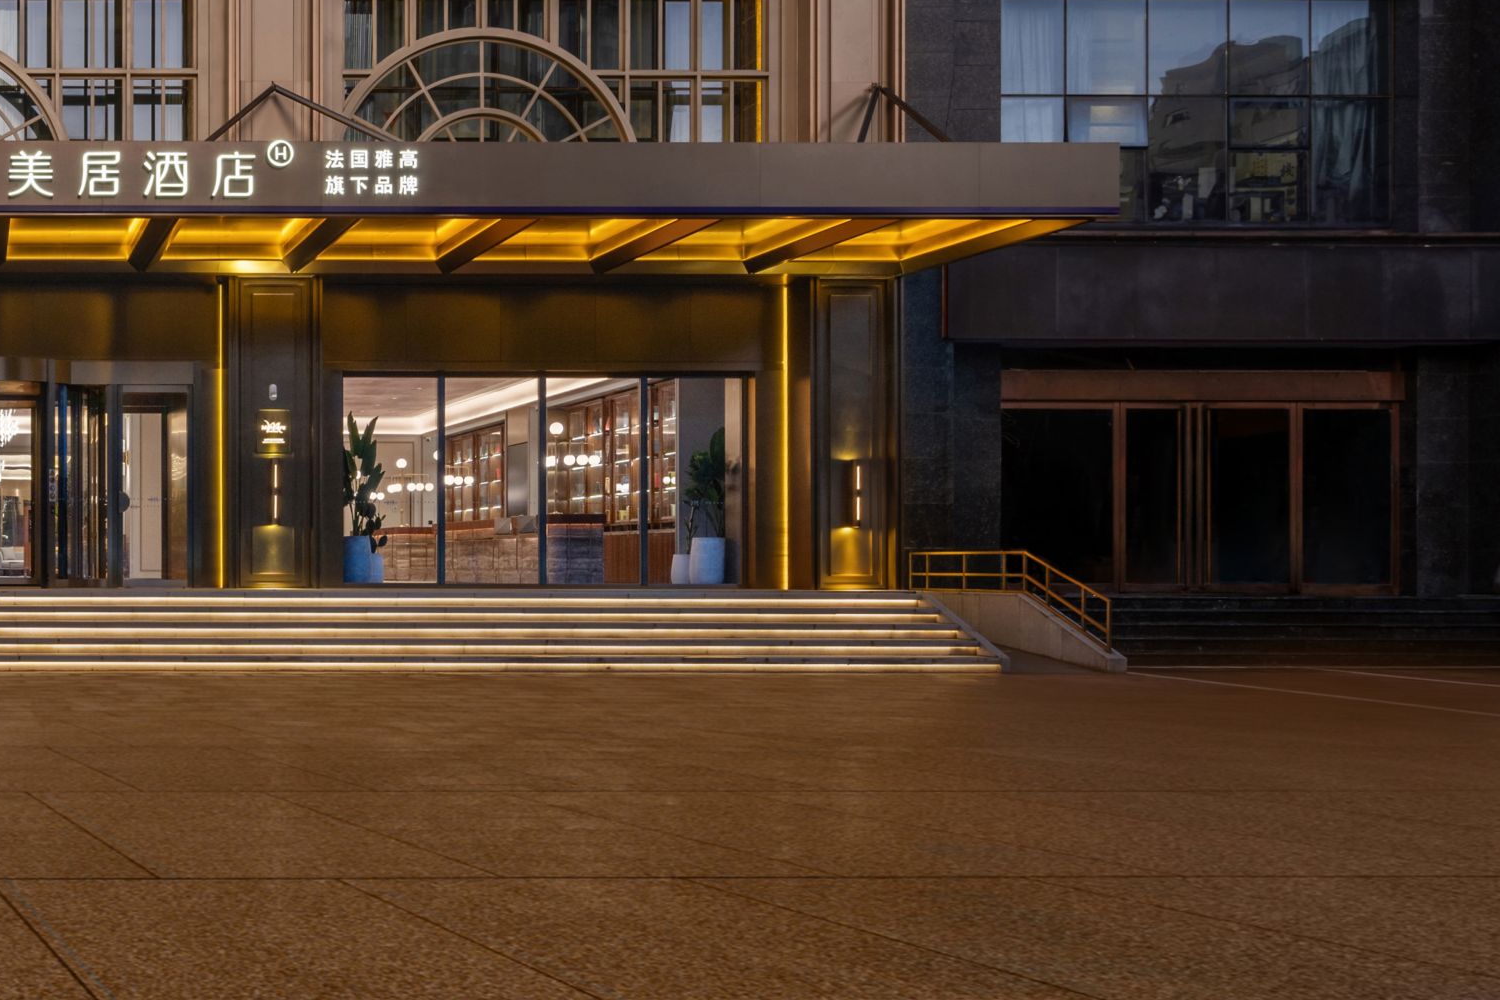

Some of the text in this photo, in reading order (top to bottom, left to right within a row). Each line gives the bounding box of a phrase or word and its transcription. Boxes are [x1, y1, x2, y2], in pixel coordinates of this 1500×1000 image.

[325, 149, 418, 169] 法国雅高
[8, 151, 256, 197] 美居酒店
[325, 175, 418, 195] 旗下品牌
